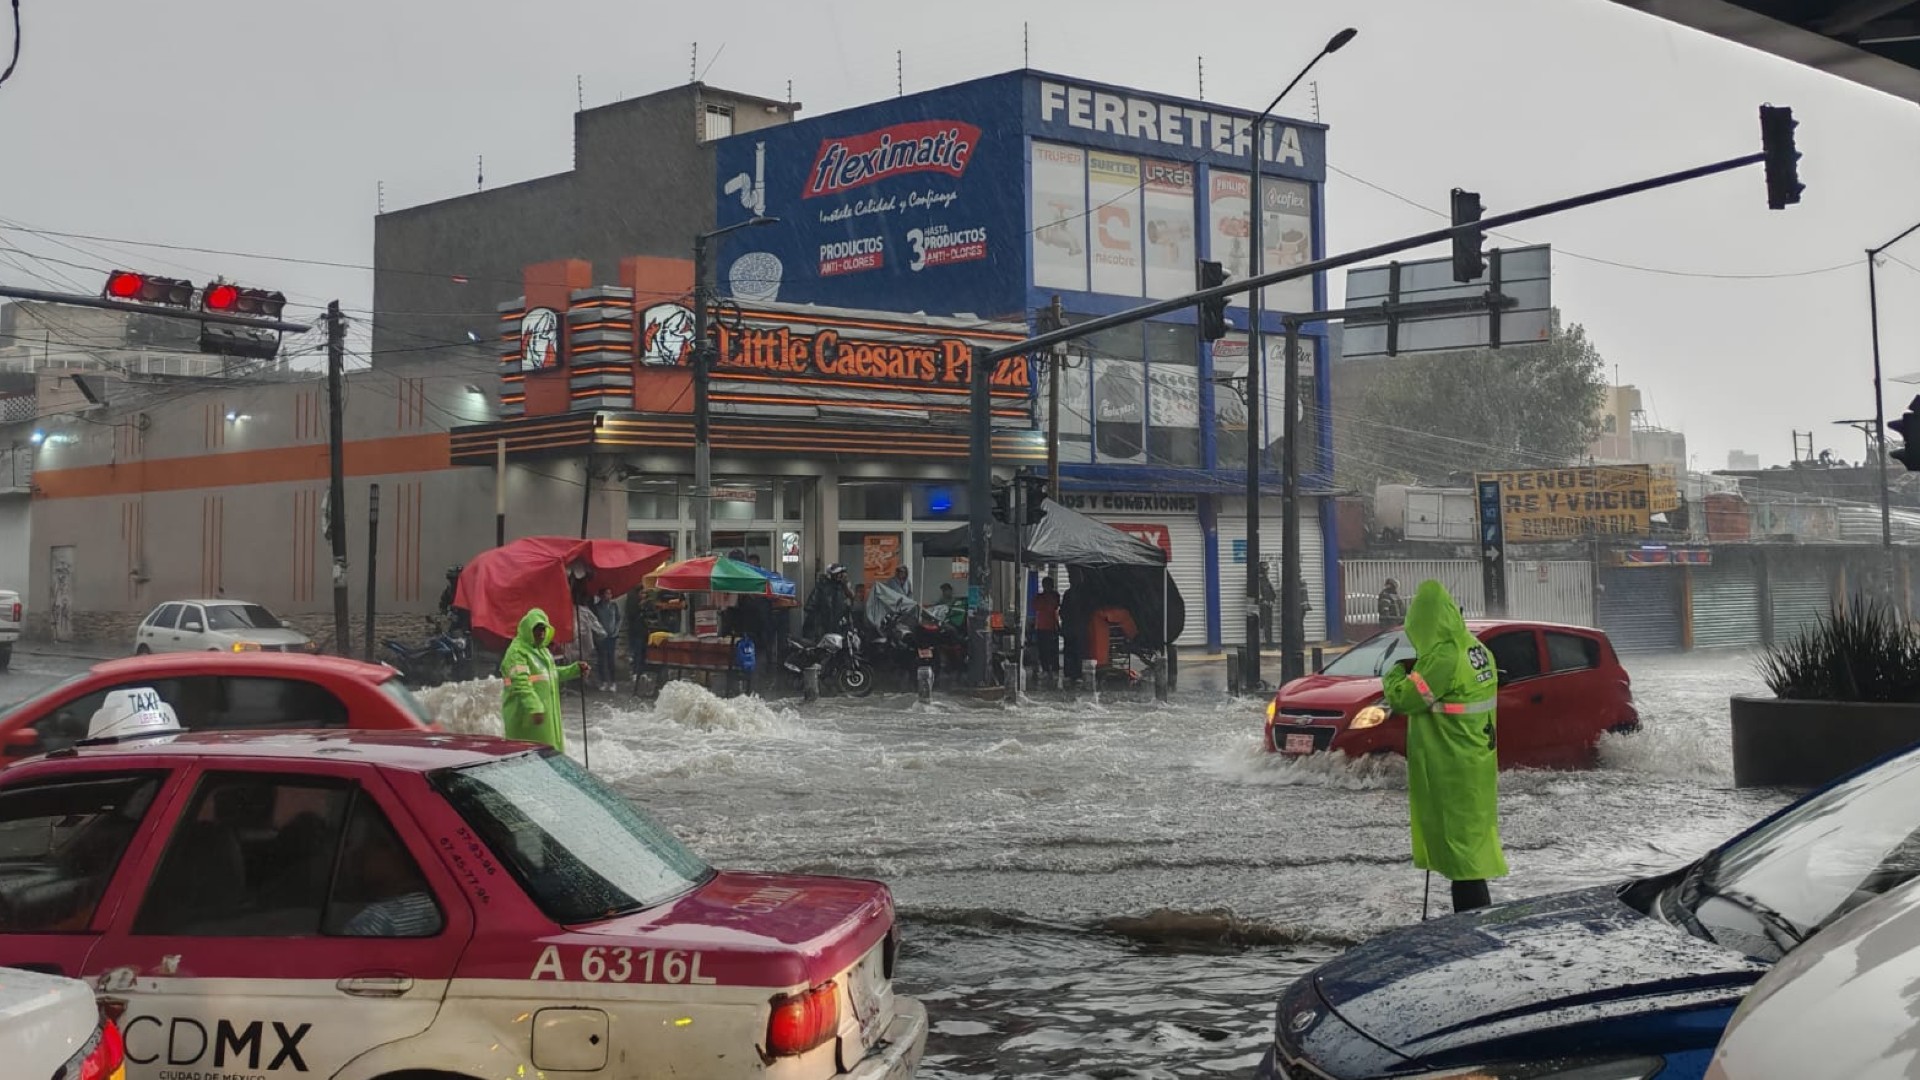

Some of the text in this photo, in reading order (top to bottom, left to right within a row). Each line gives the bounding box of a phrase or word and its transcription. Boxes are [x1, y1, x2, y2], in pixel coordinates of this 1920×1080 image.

[812, 128, 968, 192] fleximatic
[1090, 158, 1138, 175] SURTEK
[854, 196, 896, 216] Calidad
[900, 201, 907, 213] y
[908, 189, 958, 208] Confianza
[820, 236, 884, 261] PRODUCTOS
[906, 227, 987, 272] 3 PRODUCTOS
[821, 255, 875, 275] ANTI-OLORES
[716, 325, 1031, 387] Little Caesars Piza
[1477, 471, 1597, 490] RENOS
[1089, 494, 1098, 509] Y
[128, 691, 159, 714] TAXI
[530, 944, 717, 985] A 6316L
[123, 1015, 313, 1072] CDMX
